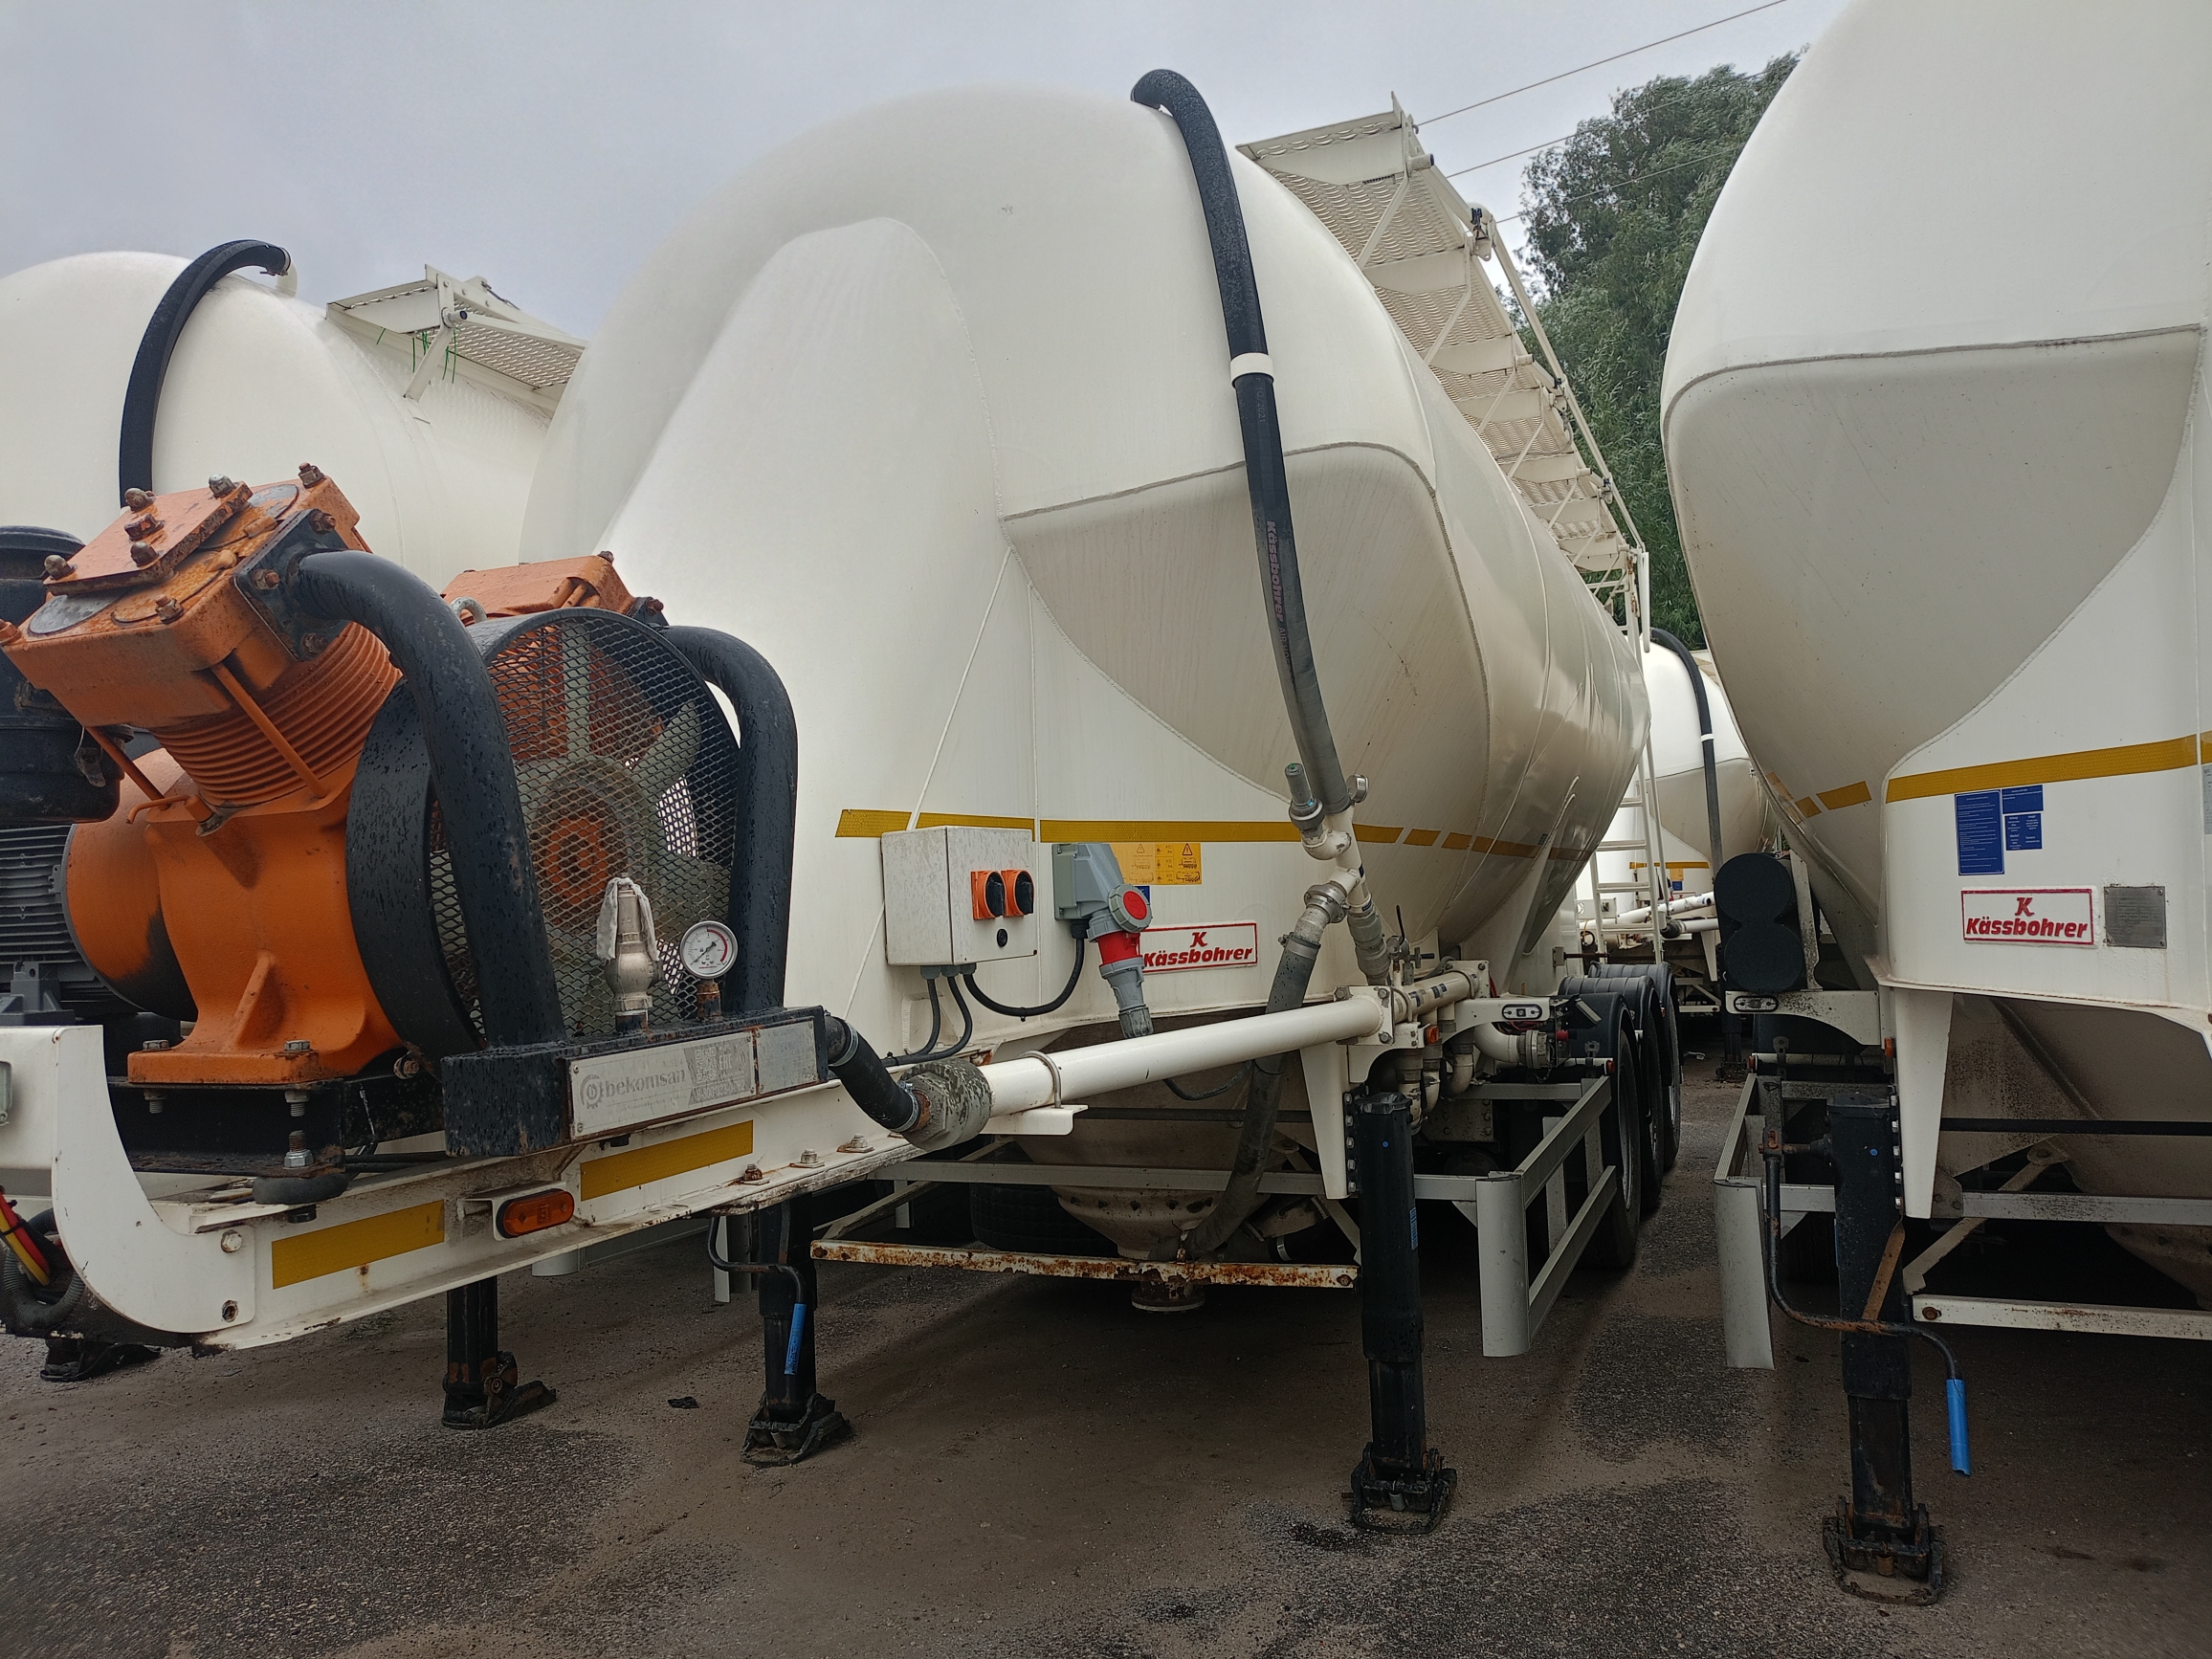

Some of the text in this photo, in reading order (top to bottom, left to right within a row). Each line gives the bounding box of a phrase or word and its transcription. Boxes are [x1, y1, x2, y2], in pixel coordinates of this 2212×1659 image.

[1266, 520, 1284, 623] Kässbohrer
[1965, 916, 2089, 939] Kässbohrer
[1143, 947, 1253, 968] Kässbohrer
[605, 1068, 686, 1098] bekomsan
